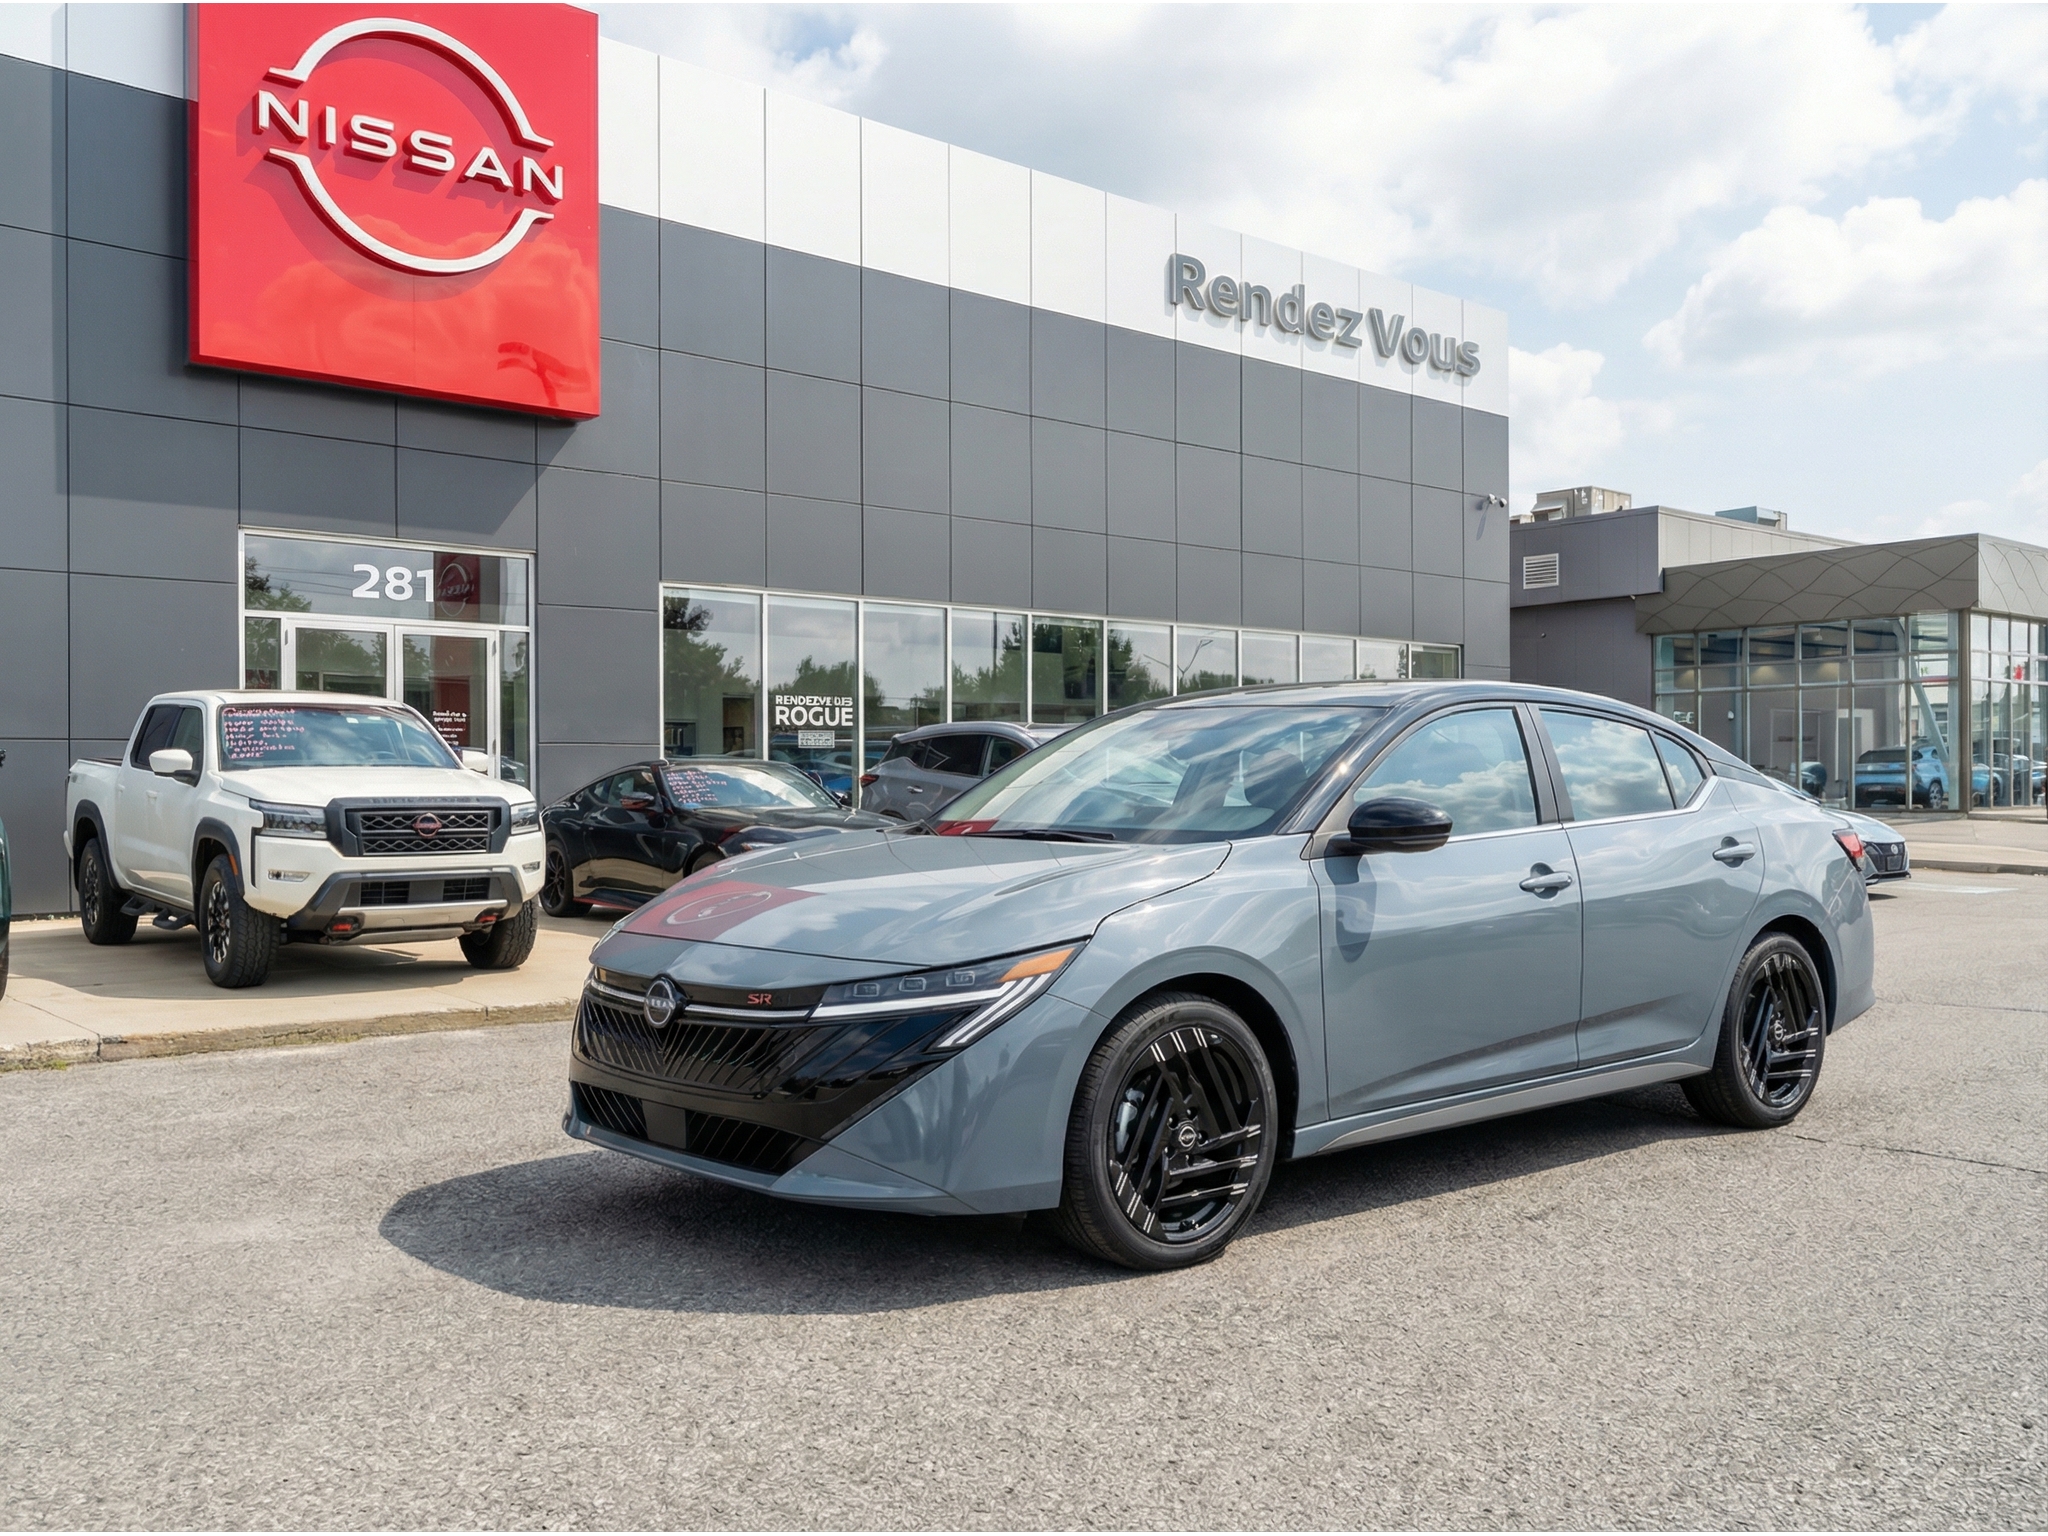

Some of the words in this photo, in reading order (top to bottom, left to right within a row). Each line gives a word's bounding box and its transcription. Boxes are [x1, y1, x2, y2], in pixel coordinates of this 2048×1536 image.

[256, 91, 564, 202] NISSAN
[1169, 253, 1363, 349] Rendez
[1370, 308, 1481, 377] Vous
[352, 564, 434, 602] 281
[775, 706, 854, 726] ROGUE
[747, 993, 772, 1005] SR
